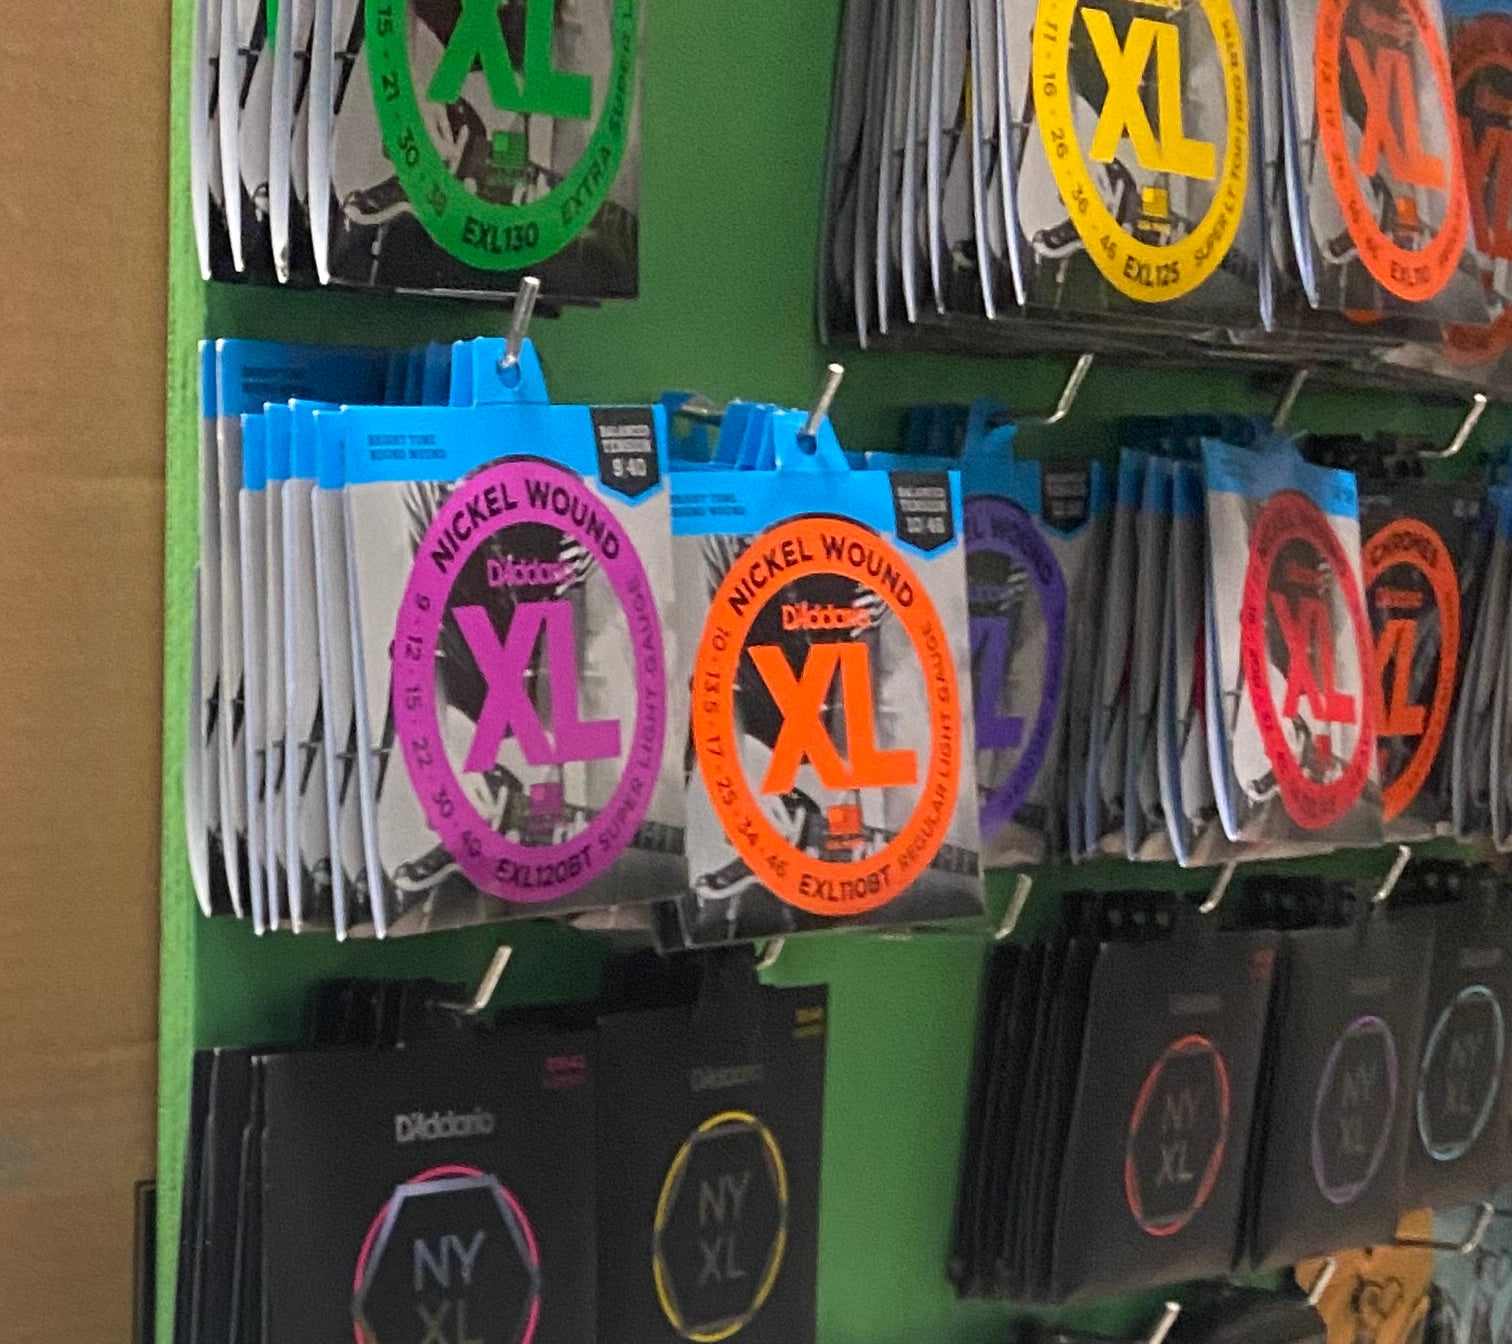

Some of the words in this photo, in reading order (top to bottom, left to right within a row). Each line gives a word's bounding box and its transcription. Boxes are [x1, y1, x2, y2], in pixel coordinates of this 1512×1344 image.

[1043, 73, 1057, 97] 16
[1081, 7, 1216, 180] XL
[1345, 36, 1446, 189] XL
[399, 127, 420, 167] 30
[460, 216, 540, 254] EXL130
[431, 482, 518, 574] NICKEL
[525, 479, 619, 560] WOUND
[728, 537, 813, 617] NICKEL
[820, 533, 914, 608] WOUND
[405, 635, 423, 662] 12
[1271, 590, 1357, 725] XL
[451, 599, 622, 773] XL
[708, 735, 725, 758] 17
[748, 642, 918, 795] XL
[412, 736, 434, 769] 22
[599, 778, 644, 852] SUPER
[638, 690, 658, 769] LIGHT
[700, 1172, 749, 1225] NY
[414, 1231, 485, 1291] NY
[697, 1236, 747, 1287] XL
